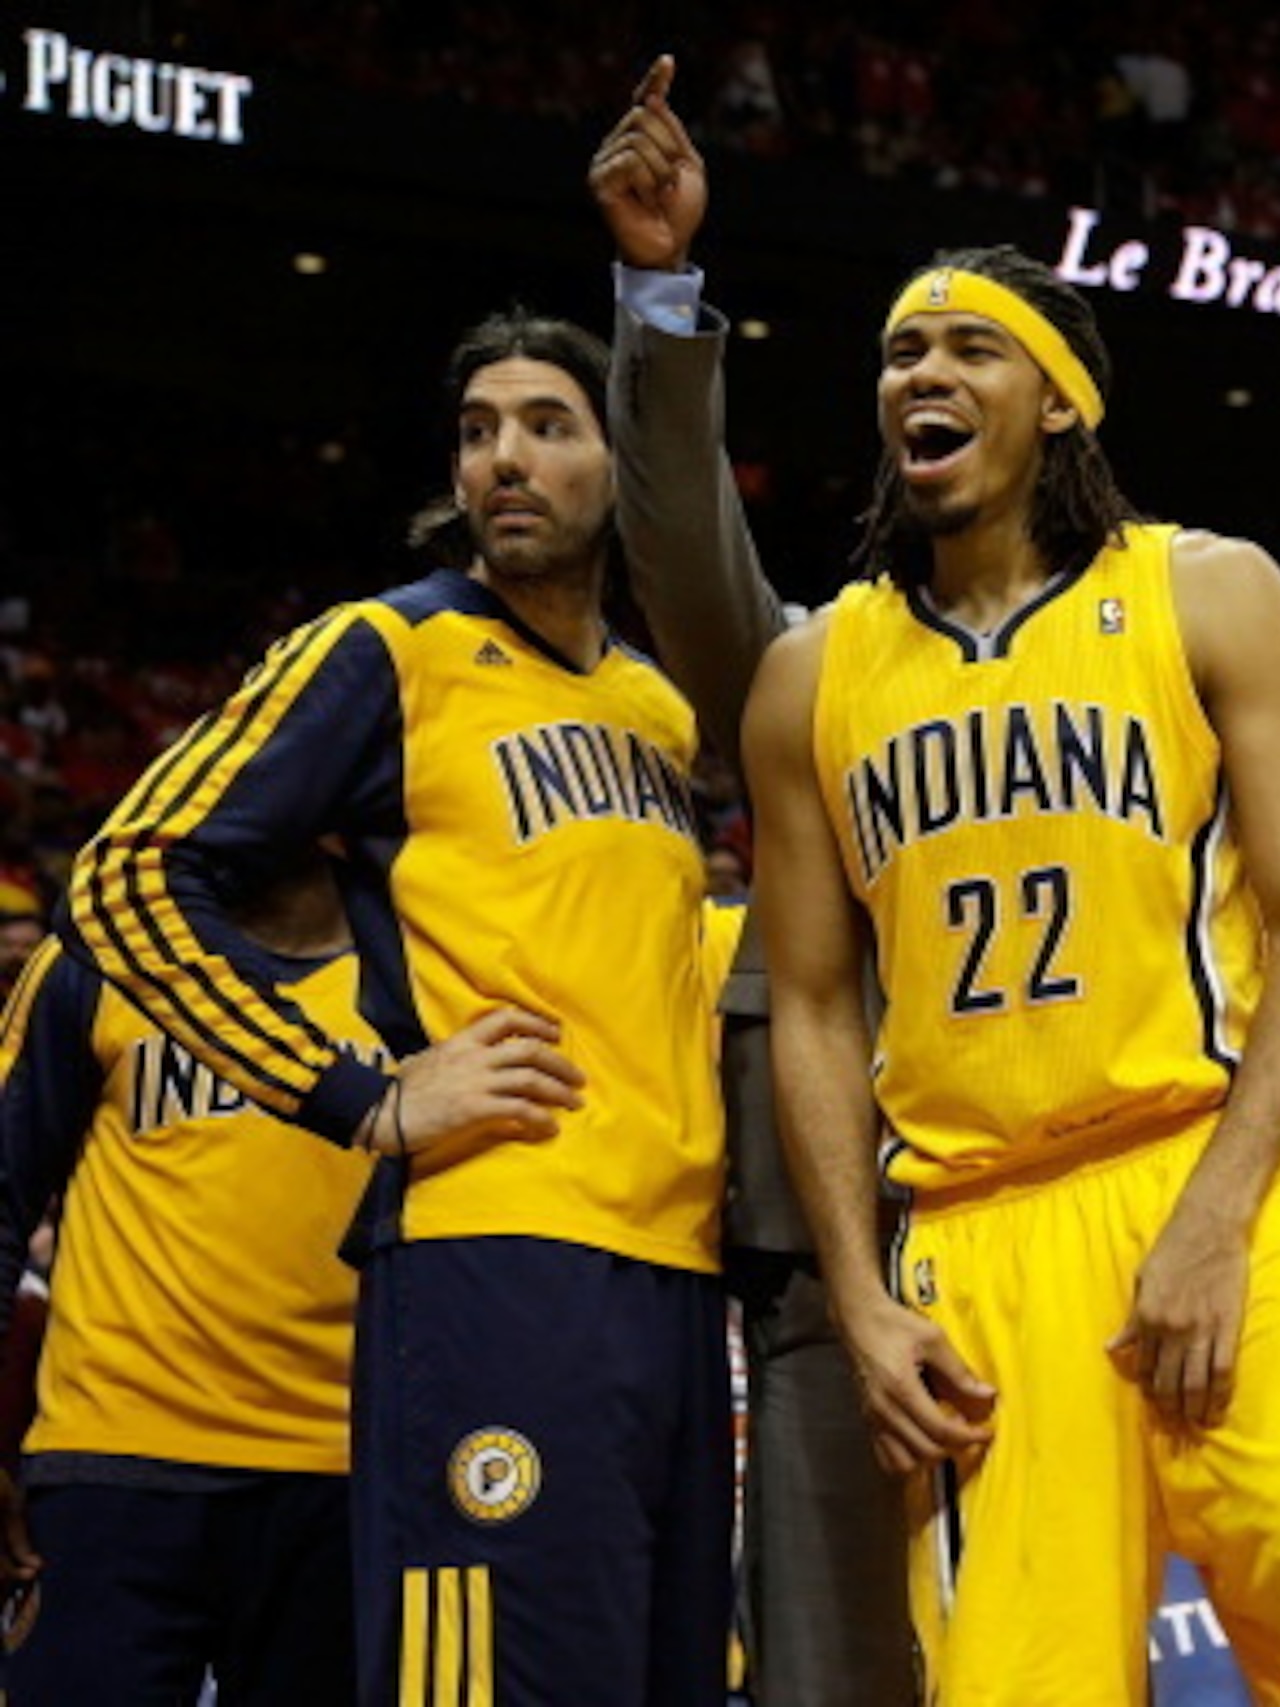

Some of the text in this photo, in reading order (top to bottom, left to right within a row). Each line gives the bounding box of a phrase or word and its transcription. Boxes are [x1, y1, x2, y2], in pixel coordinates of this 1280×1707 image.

[23, 27, 253, 144] PIGUET
[1056, 207, 1149, 291] Le
[491, 720, 698, 847] INDIAN
[845, 699, 1170, 889] INDIANA
[946, 864, 1081, 1016] 22
